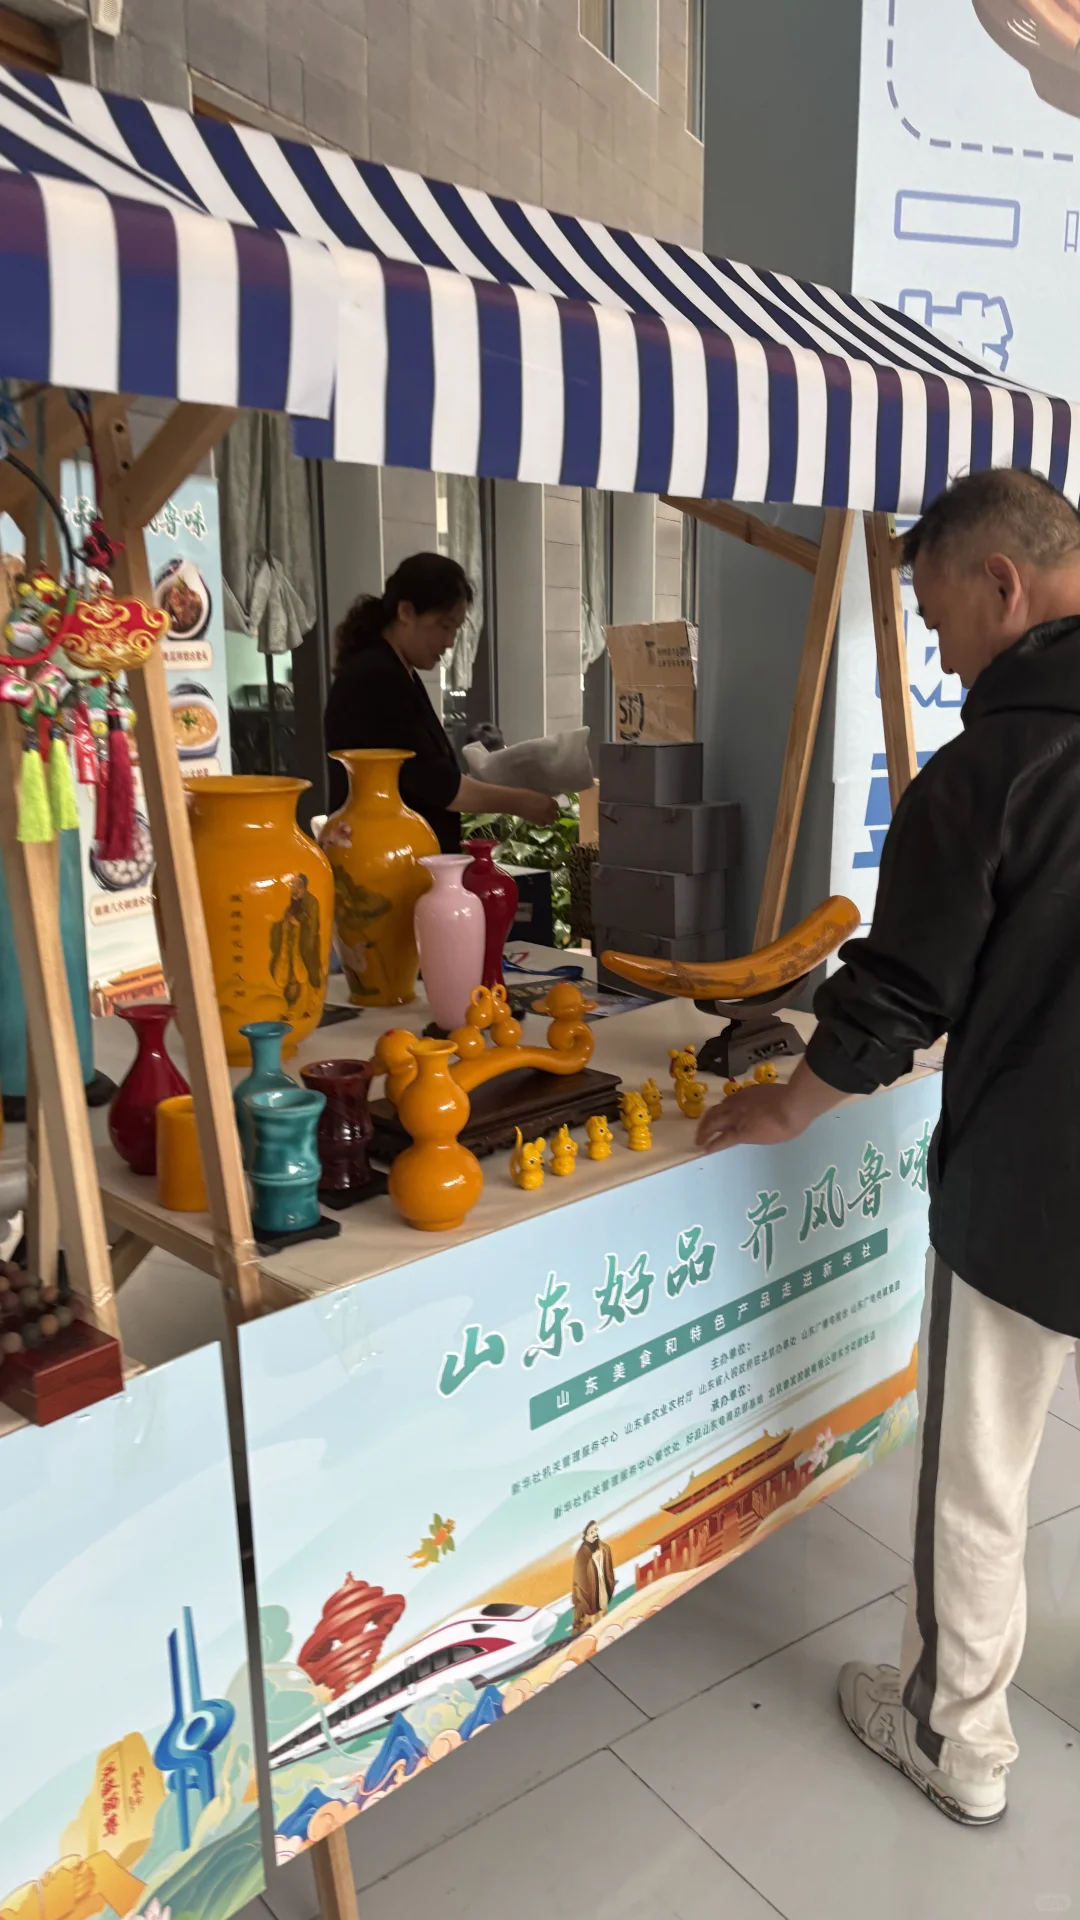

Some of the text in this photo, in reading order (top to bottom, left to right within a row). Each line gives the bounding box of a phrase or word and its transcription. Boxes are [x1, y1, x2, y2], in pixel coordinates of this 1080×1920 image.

[438, 1120, 929, 1395] 山东好品 齐风鲁味
[556, 1242, 872, 1409] 山东美食和特色产品走进新华社
